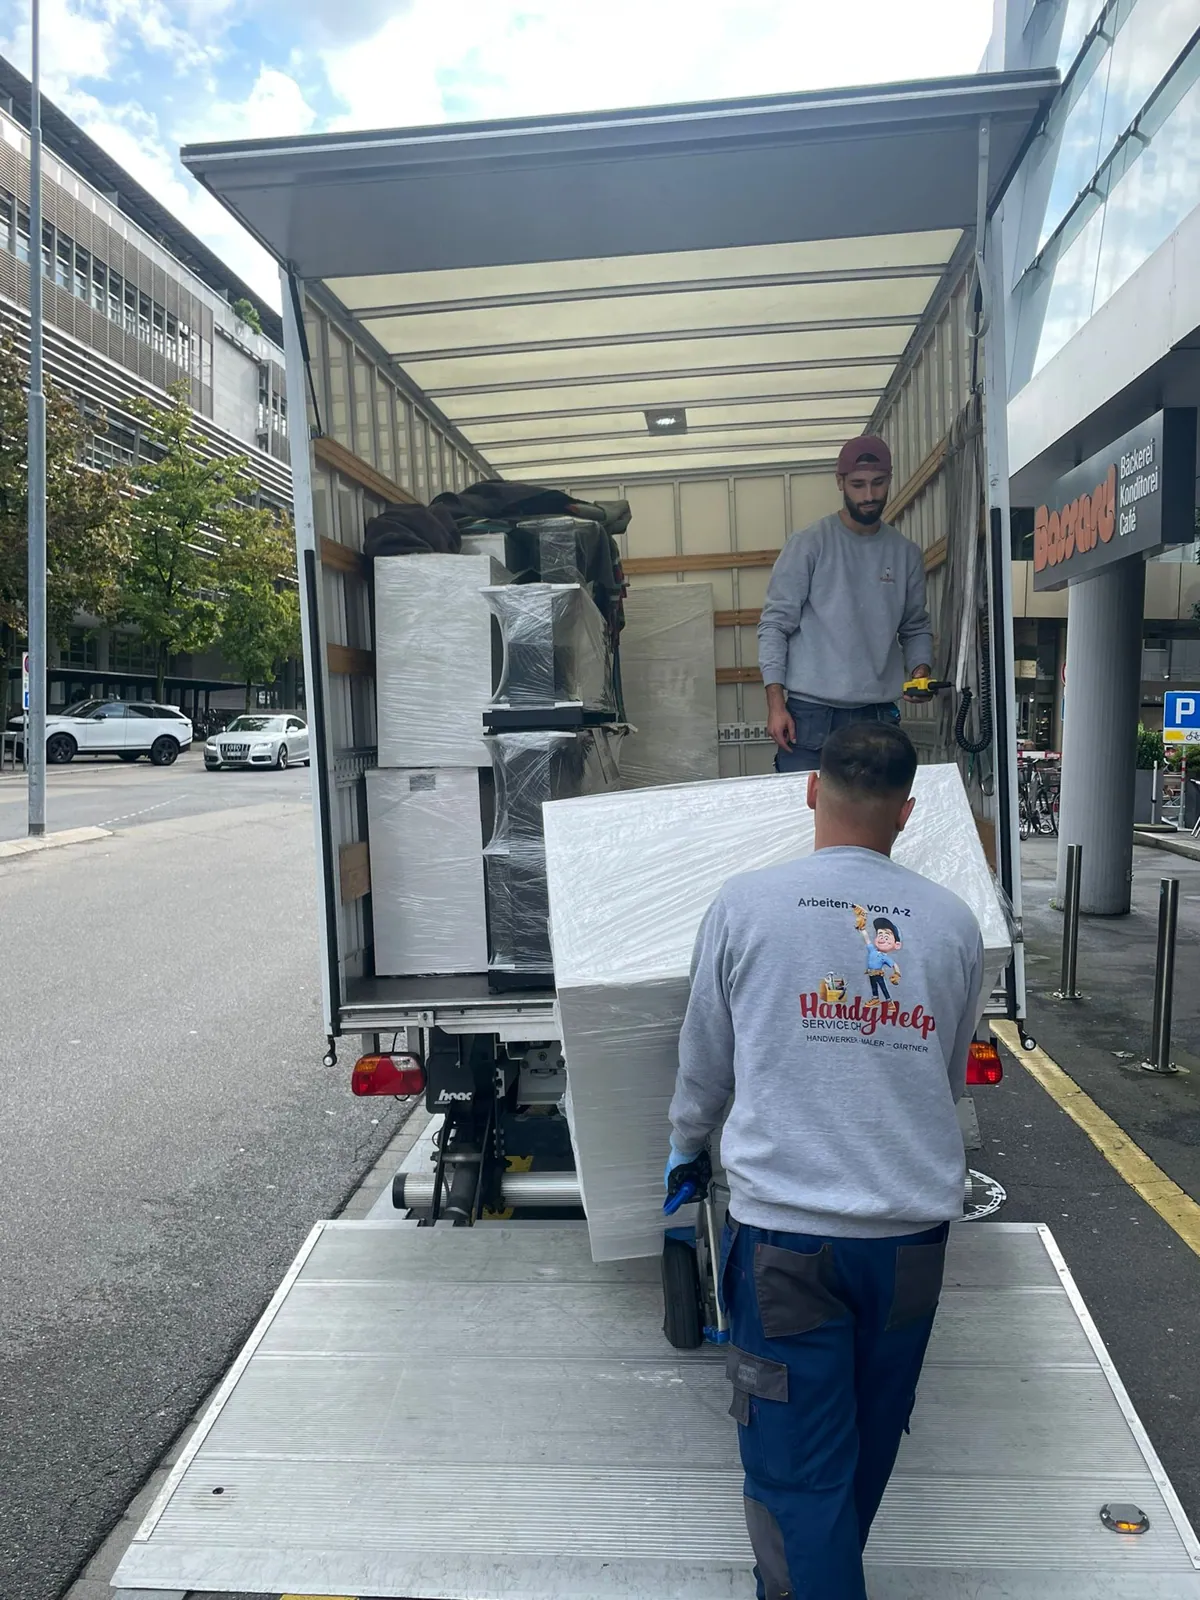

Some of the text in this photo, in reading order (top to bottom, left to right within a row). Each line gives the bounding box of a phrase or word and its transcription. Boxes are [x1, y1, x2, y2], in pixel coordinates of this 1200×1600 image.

[1120, 437, 1154, 480] Bäckerei
[1119, 465, 1159, 508] Konditorei
[1119, 506, 1136, 536] Café
[1175, 697, 1195, 725] P
[797, 897, 911, 917] Arbeiten von A-Z
